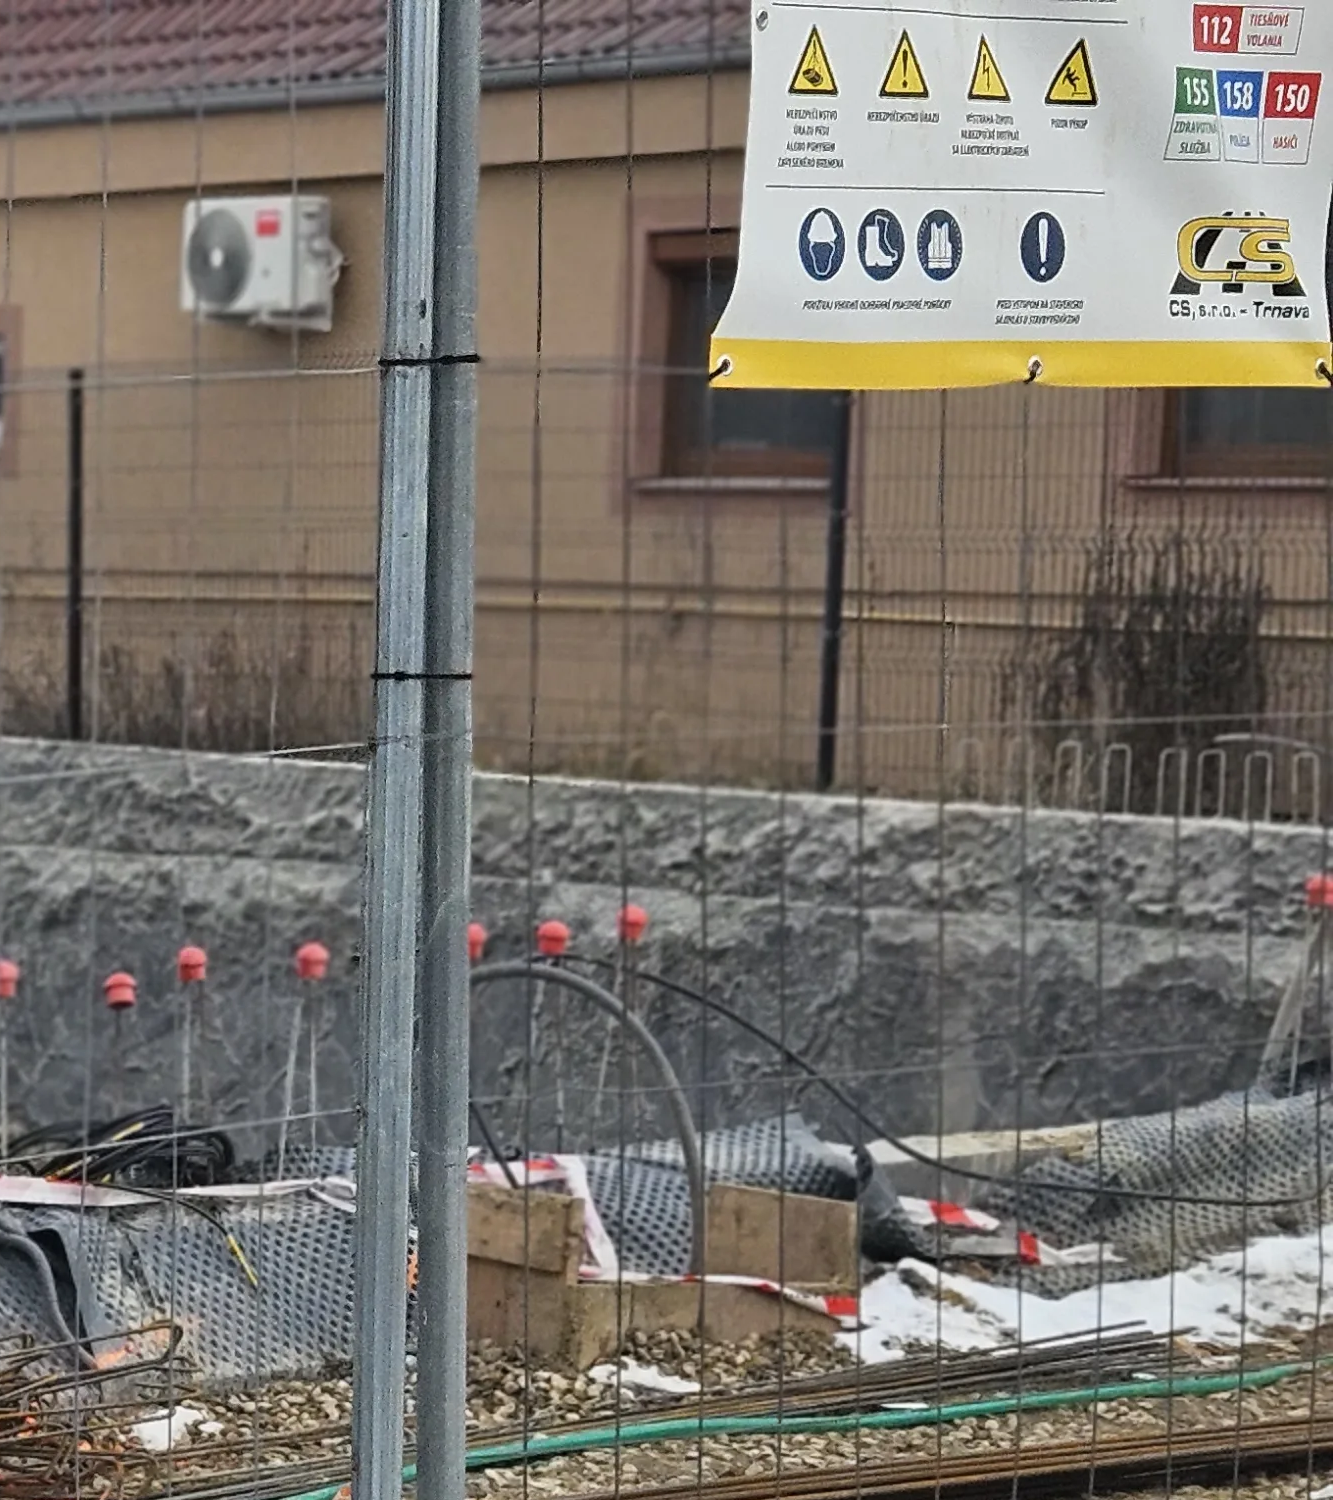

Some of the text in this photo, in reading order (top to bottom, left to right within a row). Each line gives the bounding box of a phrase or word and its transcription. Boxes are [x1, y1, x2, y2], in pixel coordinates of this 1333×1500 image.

[1200, 15, 1233, 46] 112
[1183, 76, 1210, 107] 155
[1223, 80, 1254, 111] 158
[1274, 83, 1311, 114] 150
[1177, 216, 1295, 282] CS
[1252, 300, 1310, 319] Trnava
